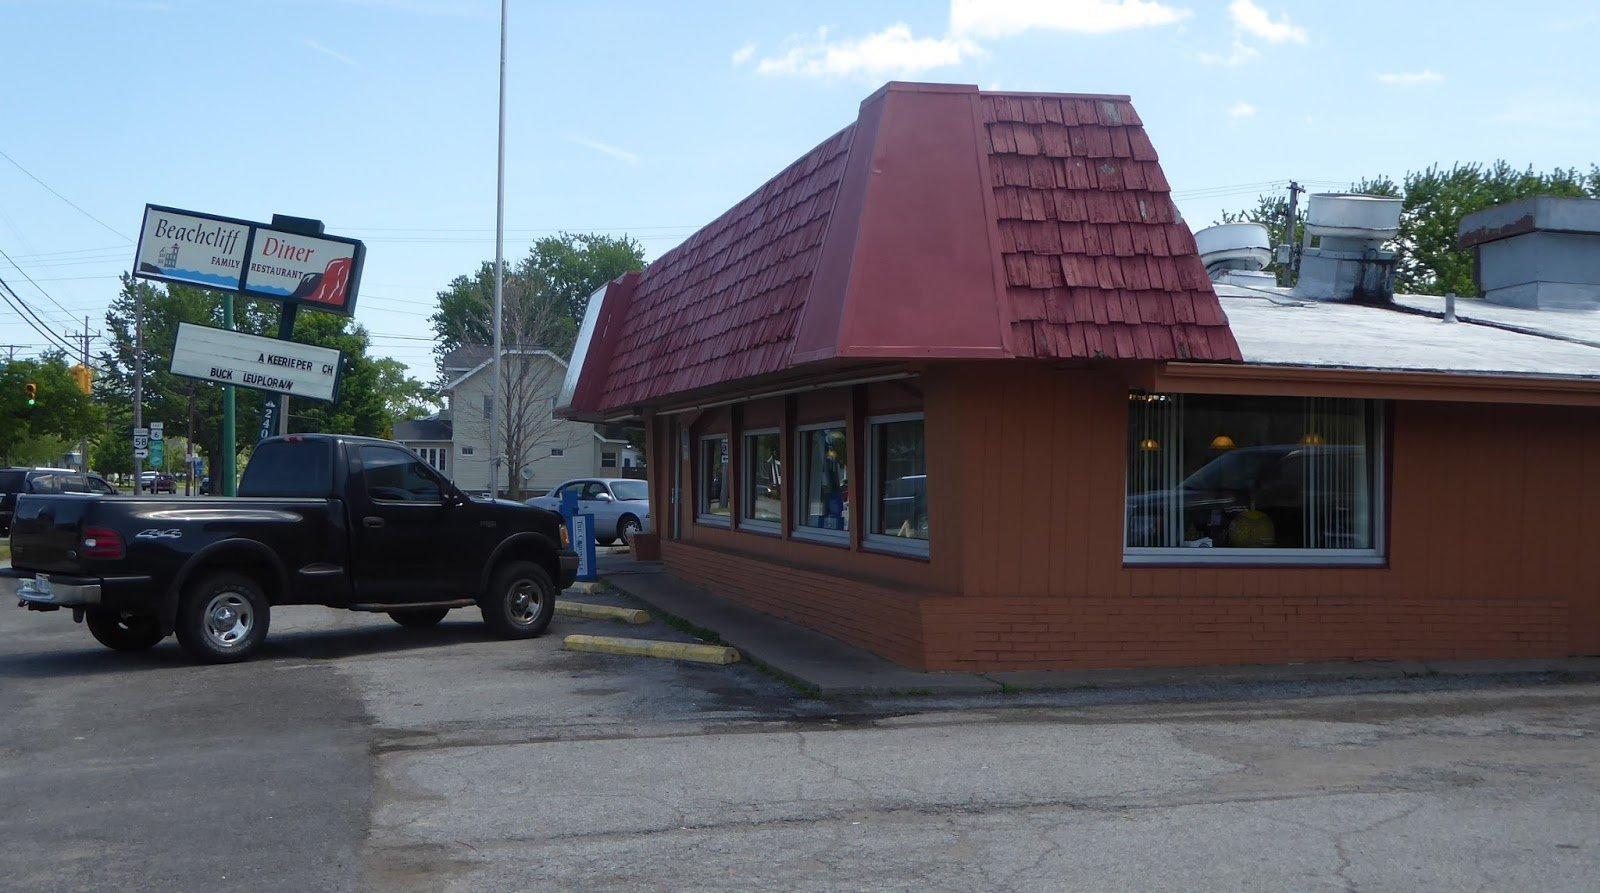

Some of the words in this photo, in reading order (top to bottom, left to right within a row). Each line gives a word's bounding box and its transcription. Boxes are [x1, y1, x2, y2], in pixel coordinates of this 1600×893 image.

[155, 219, 240, 255] Beachcliff
[262, 237, 315, 263] Diner
[211, 257, 240, 269] FAMILY
[251, 262, 303, 279] RESTAURANT
[210, 367, 233, 380] BUCK
[258, 353, 265, 363] A
[322, 364, 334, 376] CH
[135, 438, 147, 446] 58
